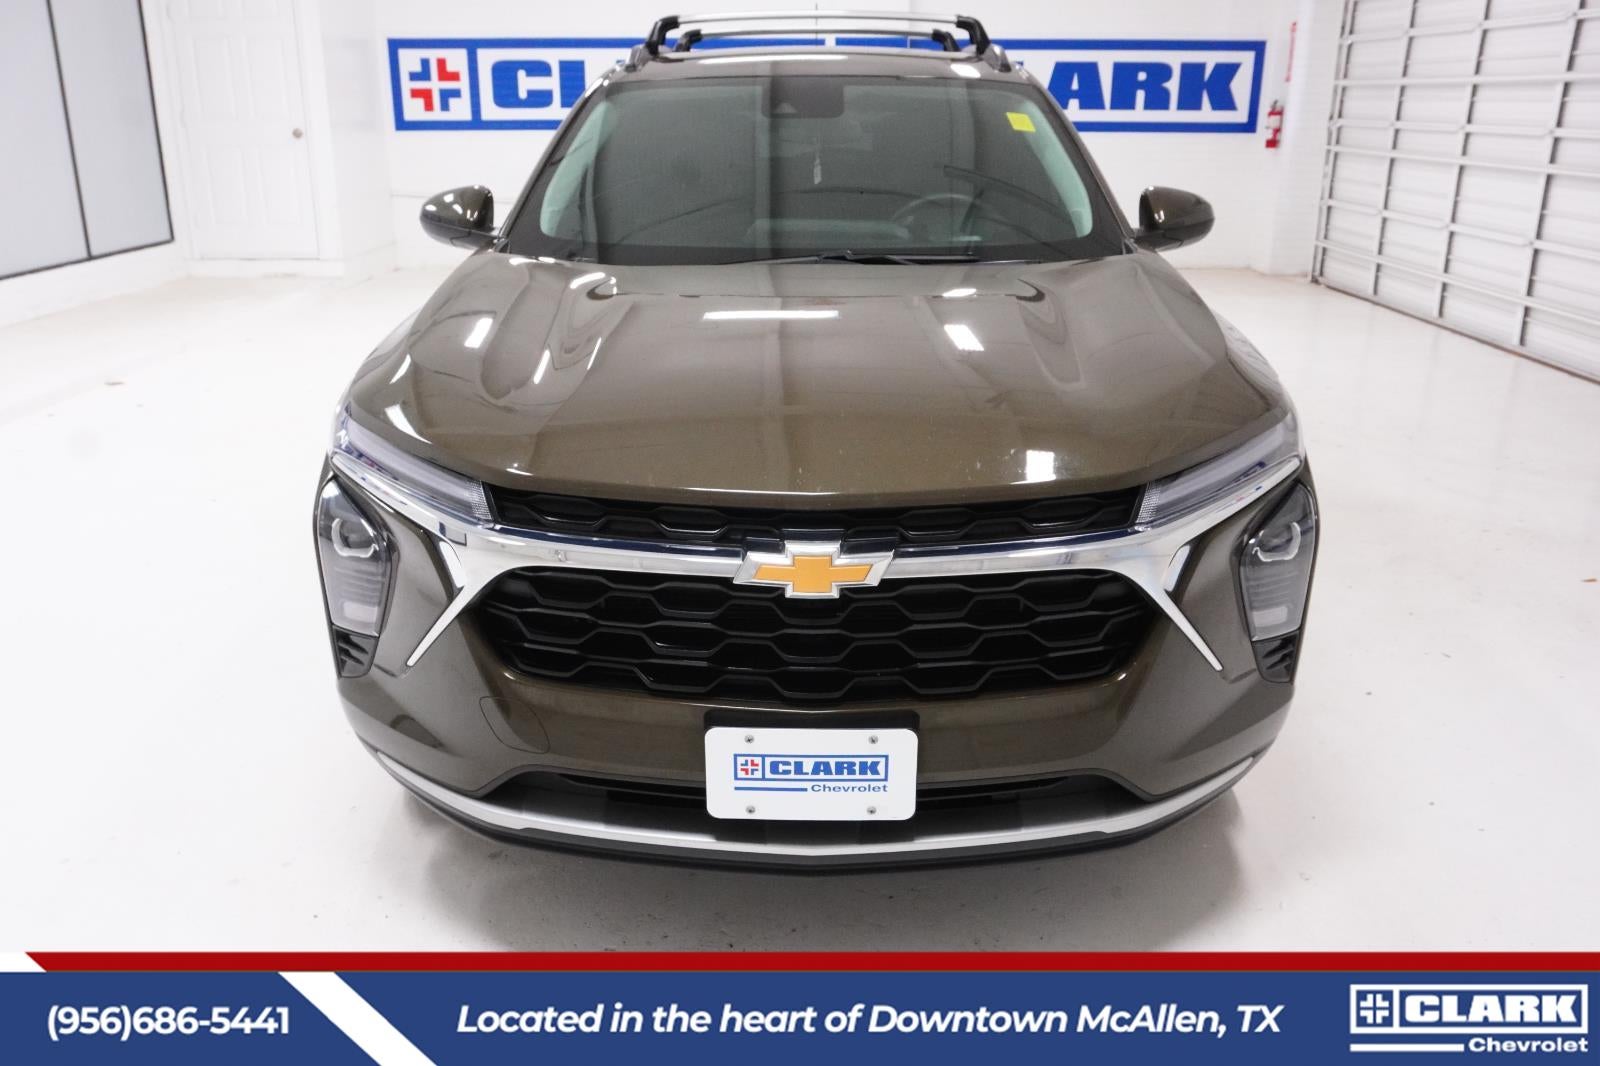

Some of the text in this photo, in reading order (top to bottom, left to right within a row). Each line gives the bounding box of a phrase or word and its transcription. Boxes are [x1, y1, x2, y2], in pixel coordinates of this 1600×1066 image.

[1047, 61, 1242, 112] ARK
[769, 760, 881, 776] CLARK
[811, 783, 888, 793] Chevrolet
